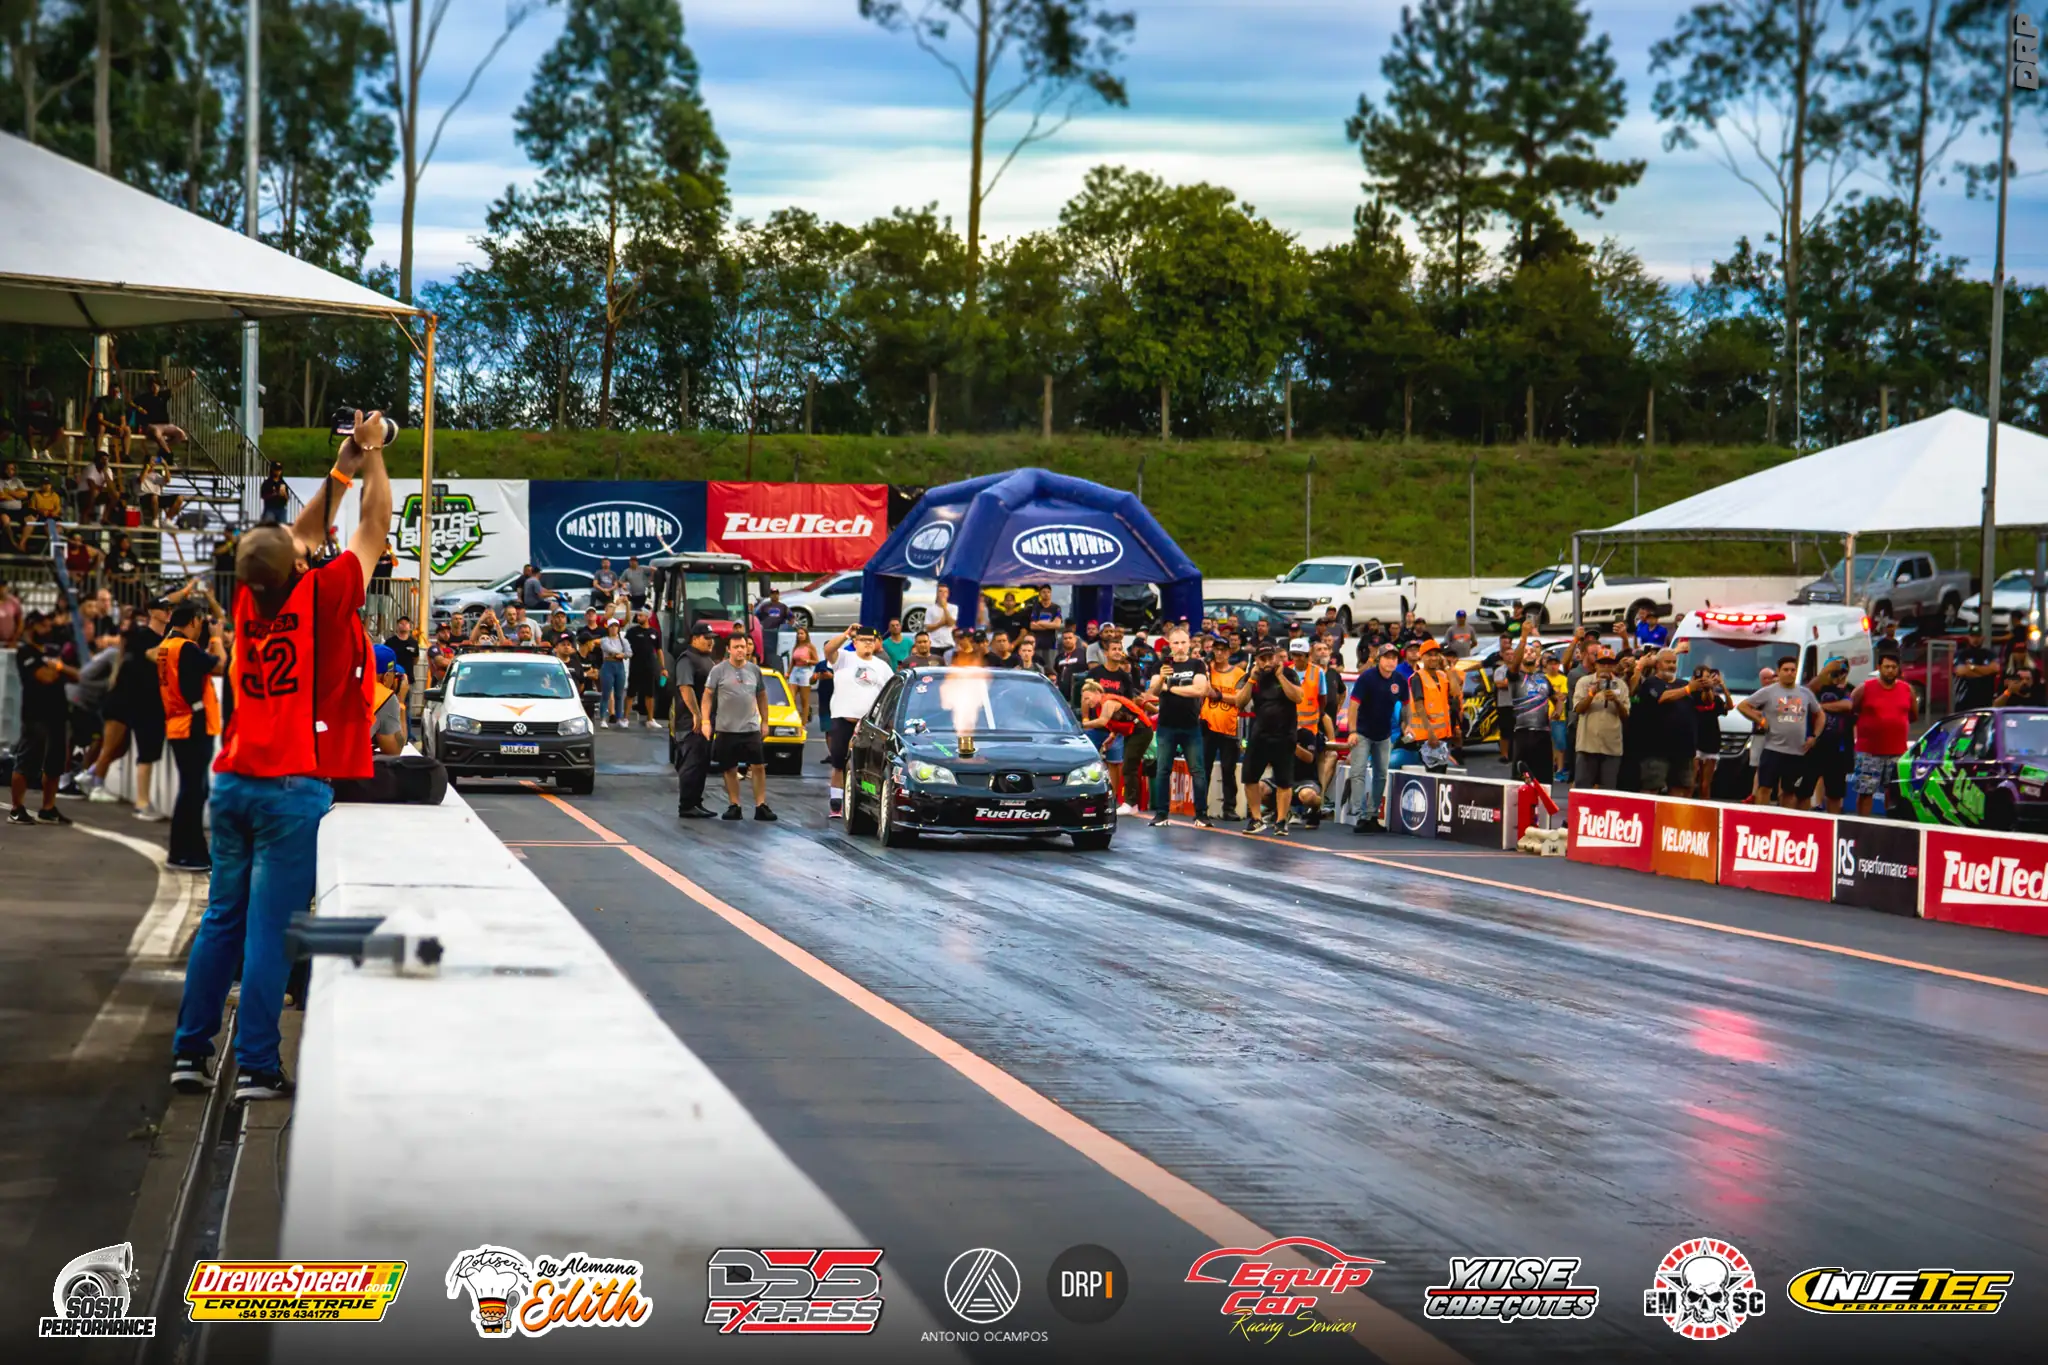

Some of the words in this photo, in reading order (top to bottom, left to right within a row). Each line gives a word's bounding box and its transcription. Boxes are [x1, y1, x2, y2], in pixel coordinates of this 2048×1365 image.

[400, 511, 479, 533] LITAS
[566, 511, 620, 538] MASTER
[625, 511, 673, 538] POWER
[723, 512, 873, 537] FuelTech
[1021, 532, 1069, 556] MASTER
[1069, 532, 1114, 556] POWER
[975, 807, 1051, 821] FuelTech
[1438, 783, 1453, 823] RS
[1577, 805, 1643, 846] FuelTech
[1661, 825, 1710, 858] VELOPARK
[1736, 824, 1819, 872] FuelTech
[1837, 838, 1855, 877] RS
